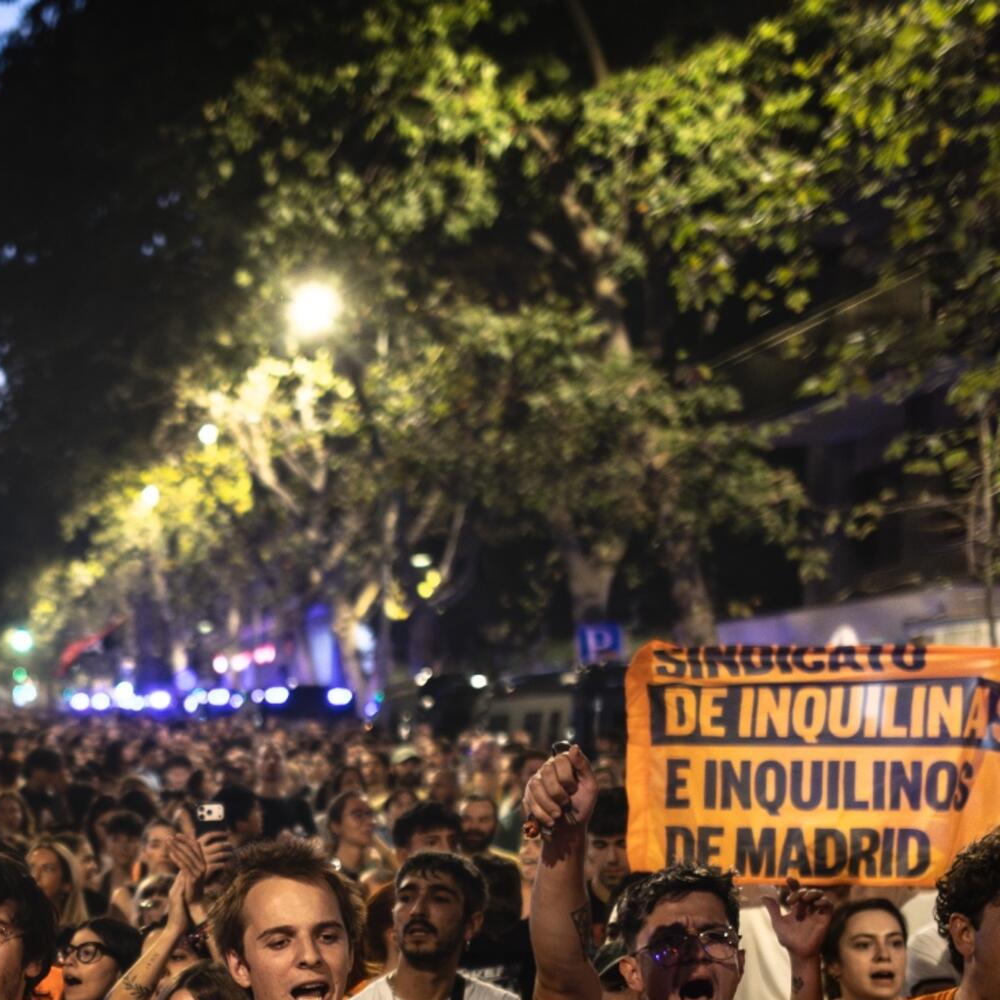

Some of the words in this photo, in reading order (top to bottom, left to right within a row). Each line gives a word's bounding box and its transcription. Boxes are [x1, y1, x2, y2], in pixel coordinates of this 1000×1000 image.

[586, 629, 612, 663] P
[664, 687, 728, 737] DE
[665, 759, 691, 809] E
[704, 760, 974, 816] INQUILINOS
[665, 825, 723, 875] DE
[735, 826, 931, 878] MADRID
